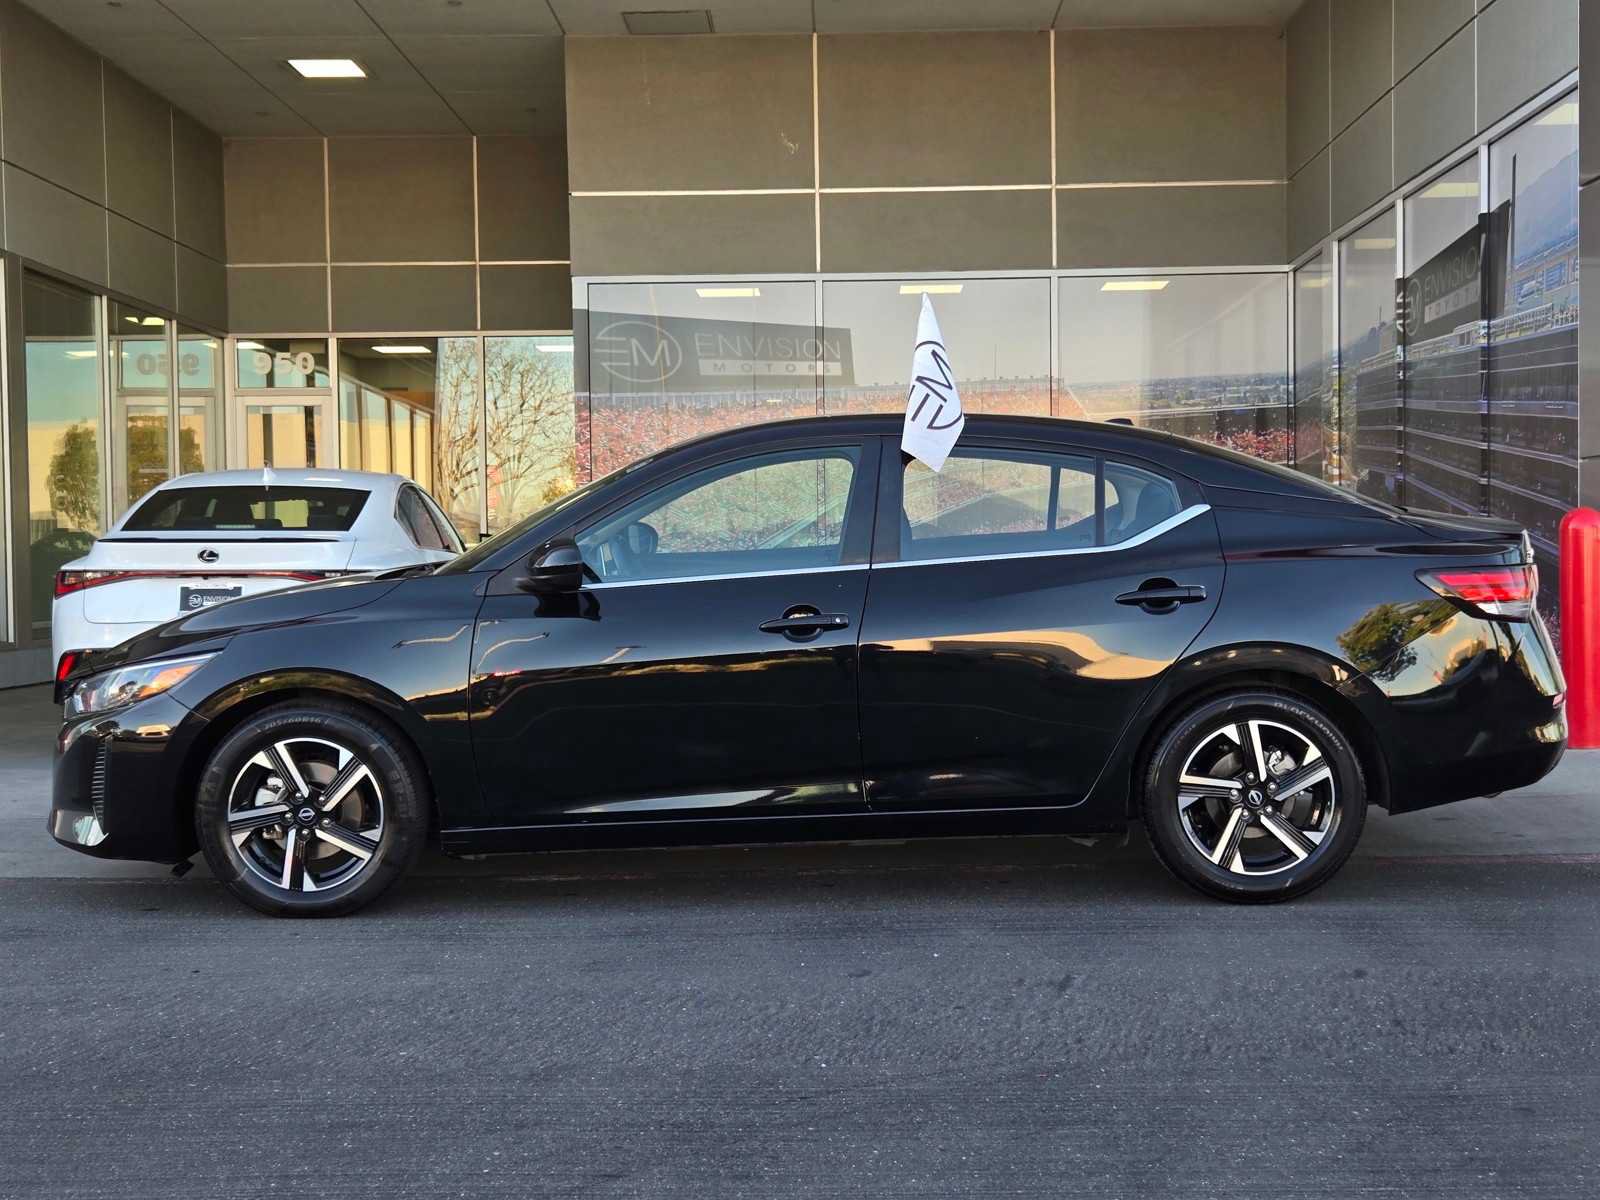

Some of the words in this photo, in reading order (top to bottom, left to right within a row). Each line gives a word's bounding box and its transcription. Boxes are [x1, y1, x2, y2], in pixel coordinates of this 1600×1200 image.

[694, 331, 840, 359] ENVISION
[253, 351, 316, 376] 950
[712, 361, 831, 374] MOTORS
